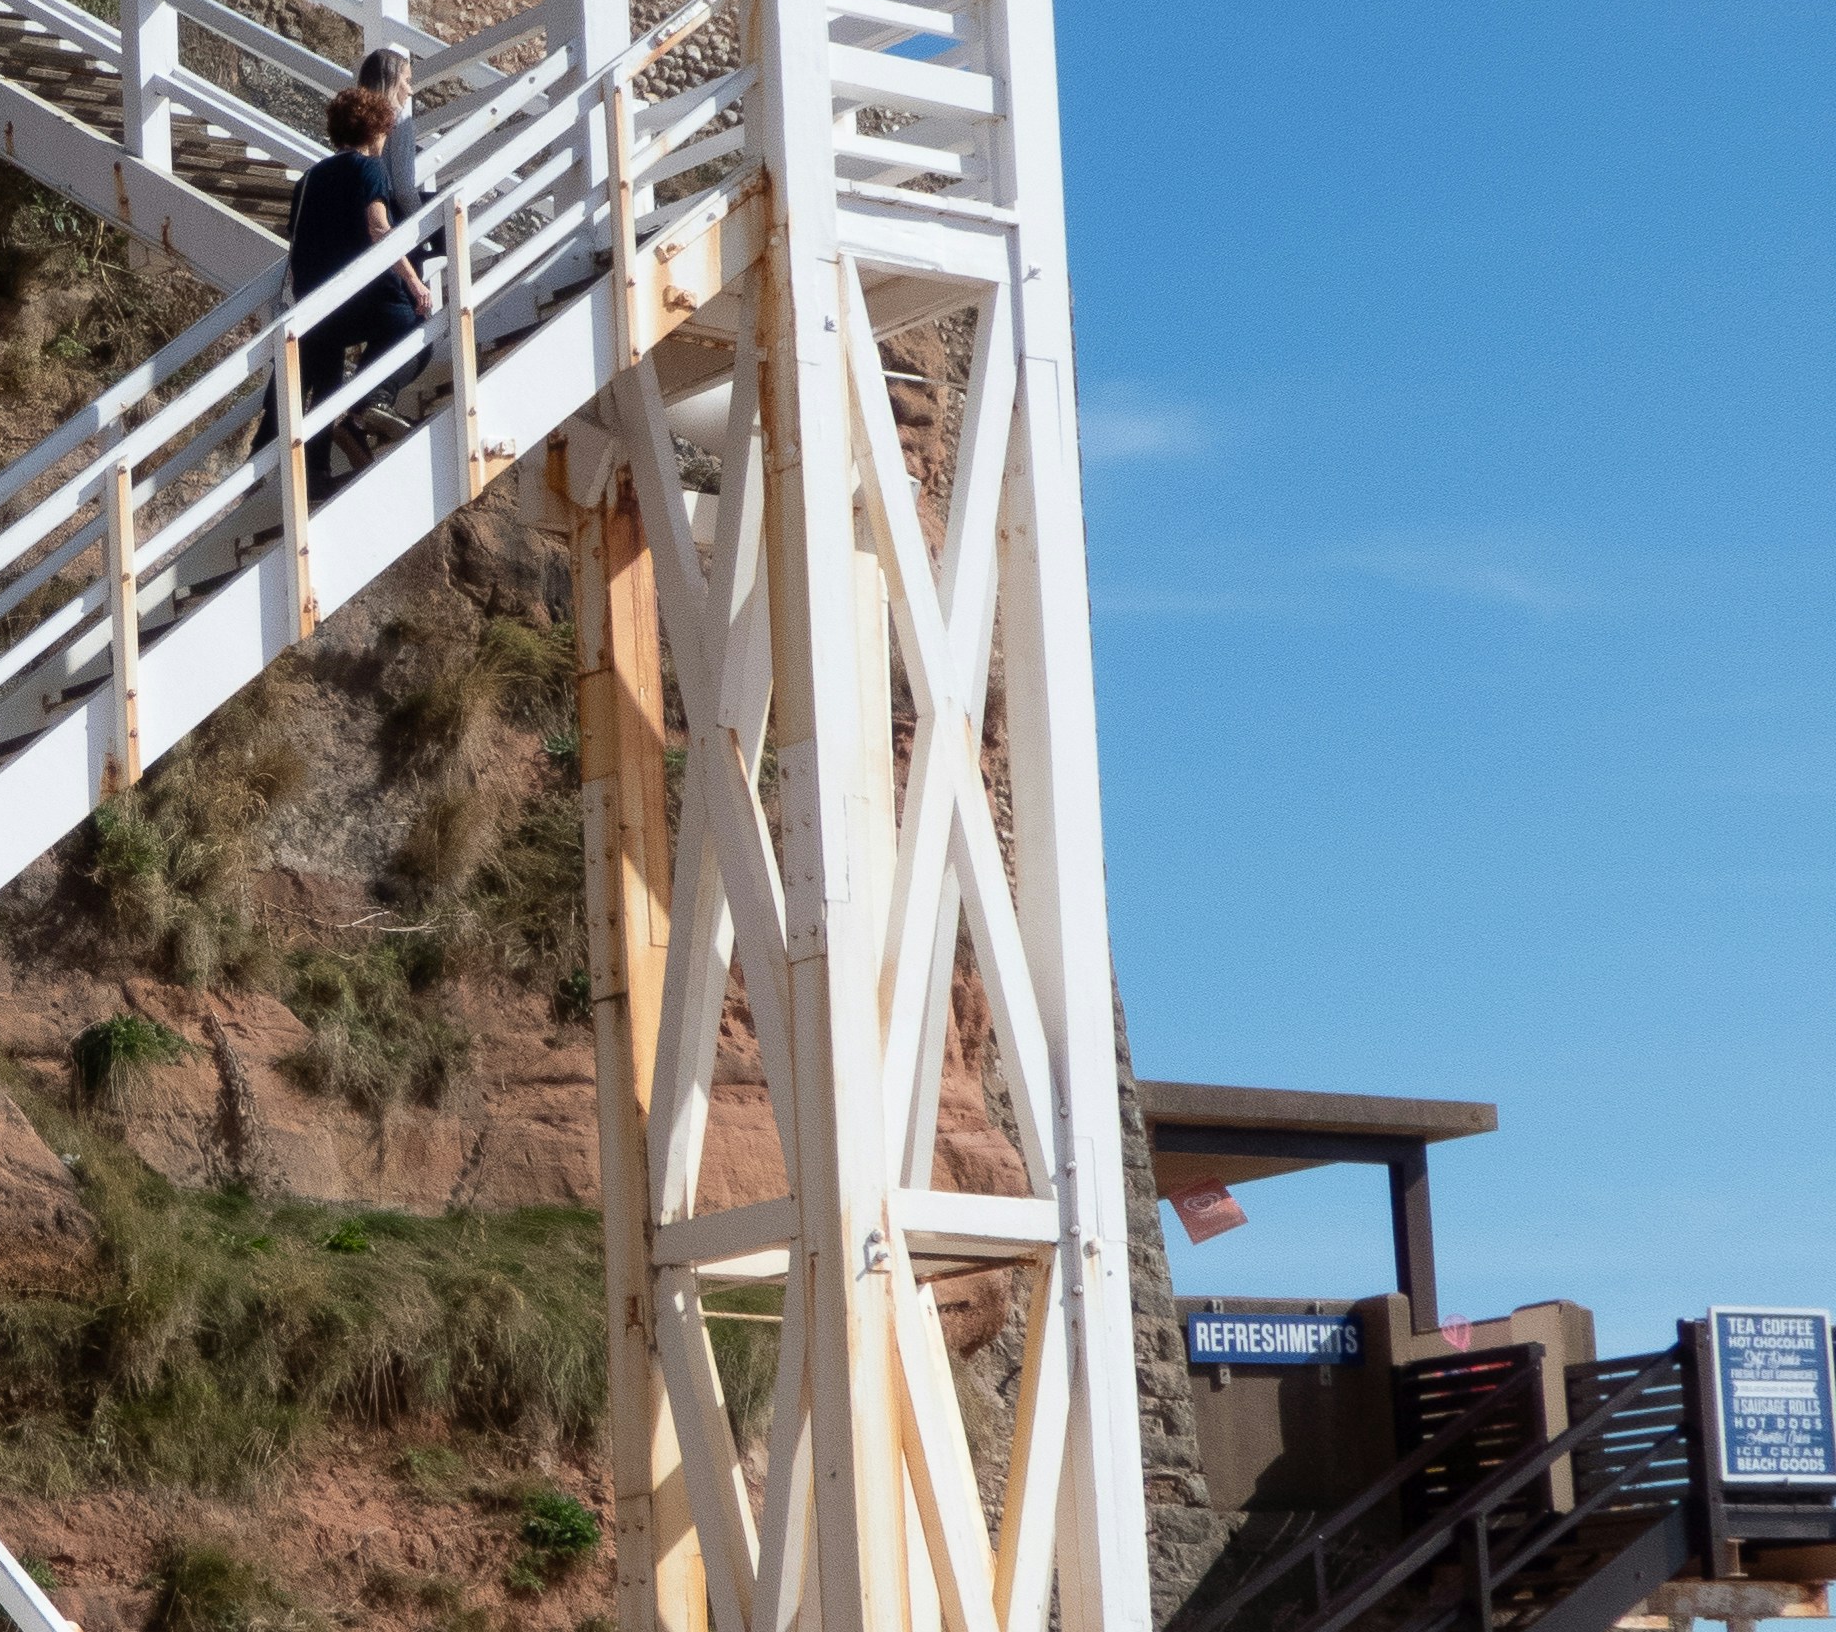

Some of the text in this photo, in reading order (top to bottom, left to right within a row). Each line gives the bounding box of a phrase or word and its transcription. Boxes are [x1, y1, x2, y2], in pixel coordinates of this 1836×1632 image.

[1727, 1317, 1815, 1336] TEA COFFEE
[1196, 1322, 1358, 1354] REFRESHMENTS
[1728, 1336, 1816, 1350] HOT CHOCOLATE
[1741, 1398, 1787, 1415] SAUSAGE
[1788, 1399, 1821, 1416] ROLLS
[1734, 1416, 1823, 1431] HOT DOGS
[1736, 1447, 1825, 1458] ICE CREAM
[1737, 1458, 1826, 1472] BEACH GOODS
